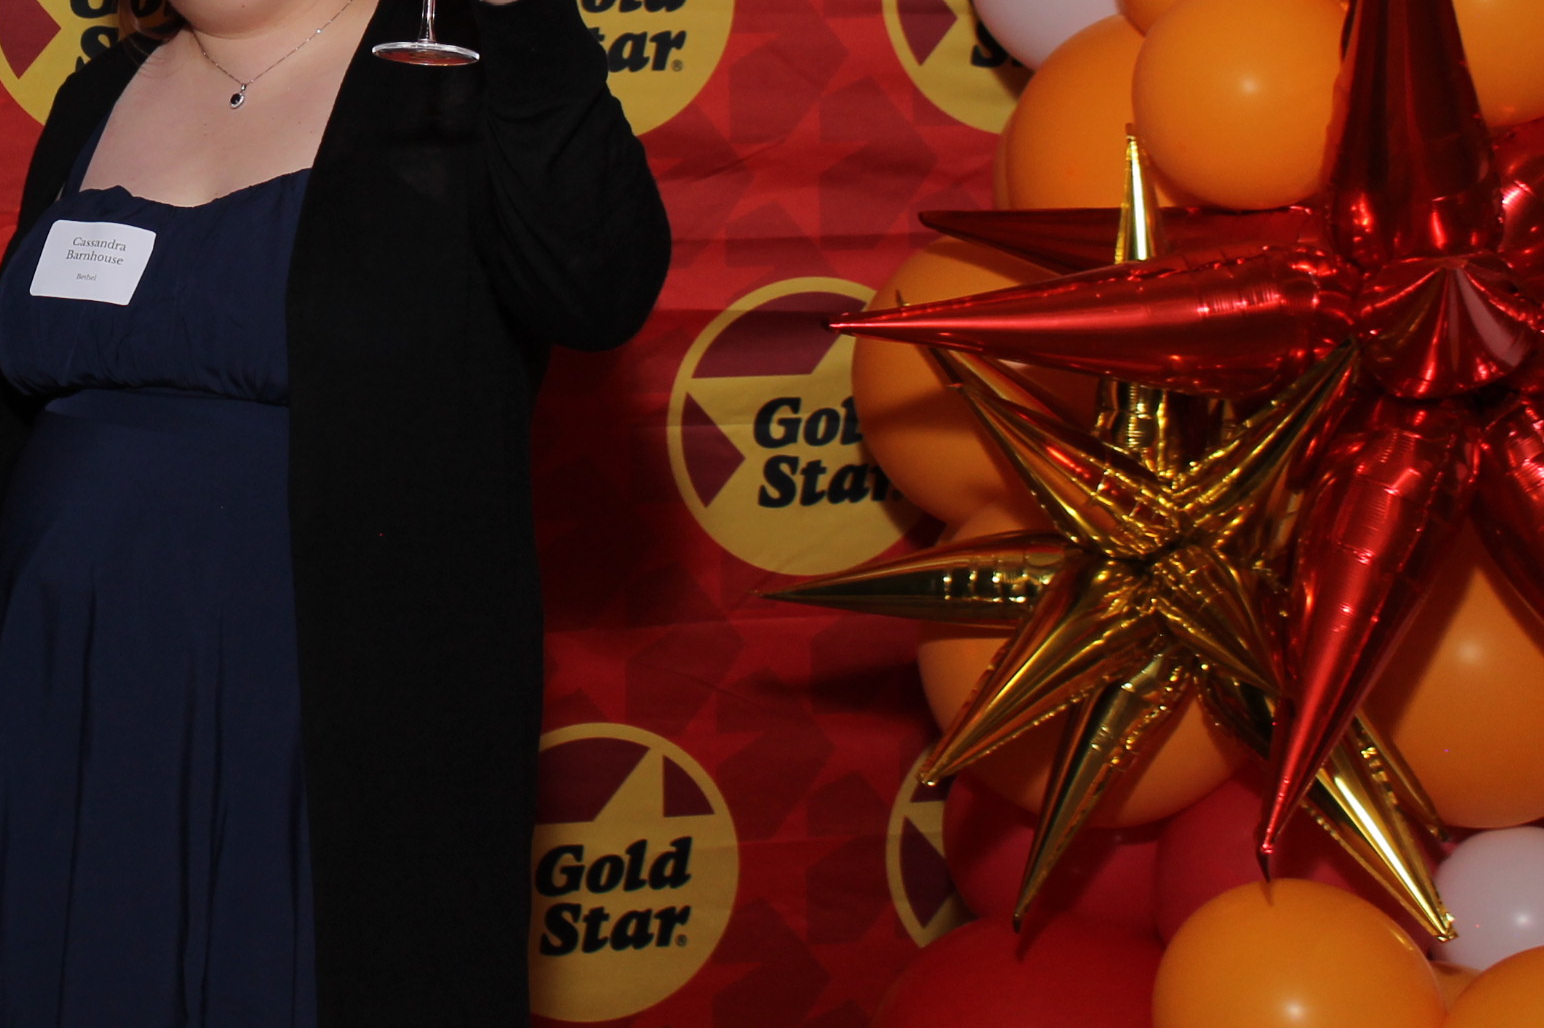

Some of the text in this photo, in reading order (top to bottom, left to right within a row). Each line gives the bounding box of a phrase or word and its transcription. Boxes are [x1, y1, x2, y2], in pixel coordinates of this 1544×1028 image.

[65, 249, 124, 265] Barnhouse
[72, 236, 127, 252] Cassandra
[753, 395, 863, 449] Gol
[535, 836, 693, 897] Gold
